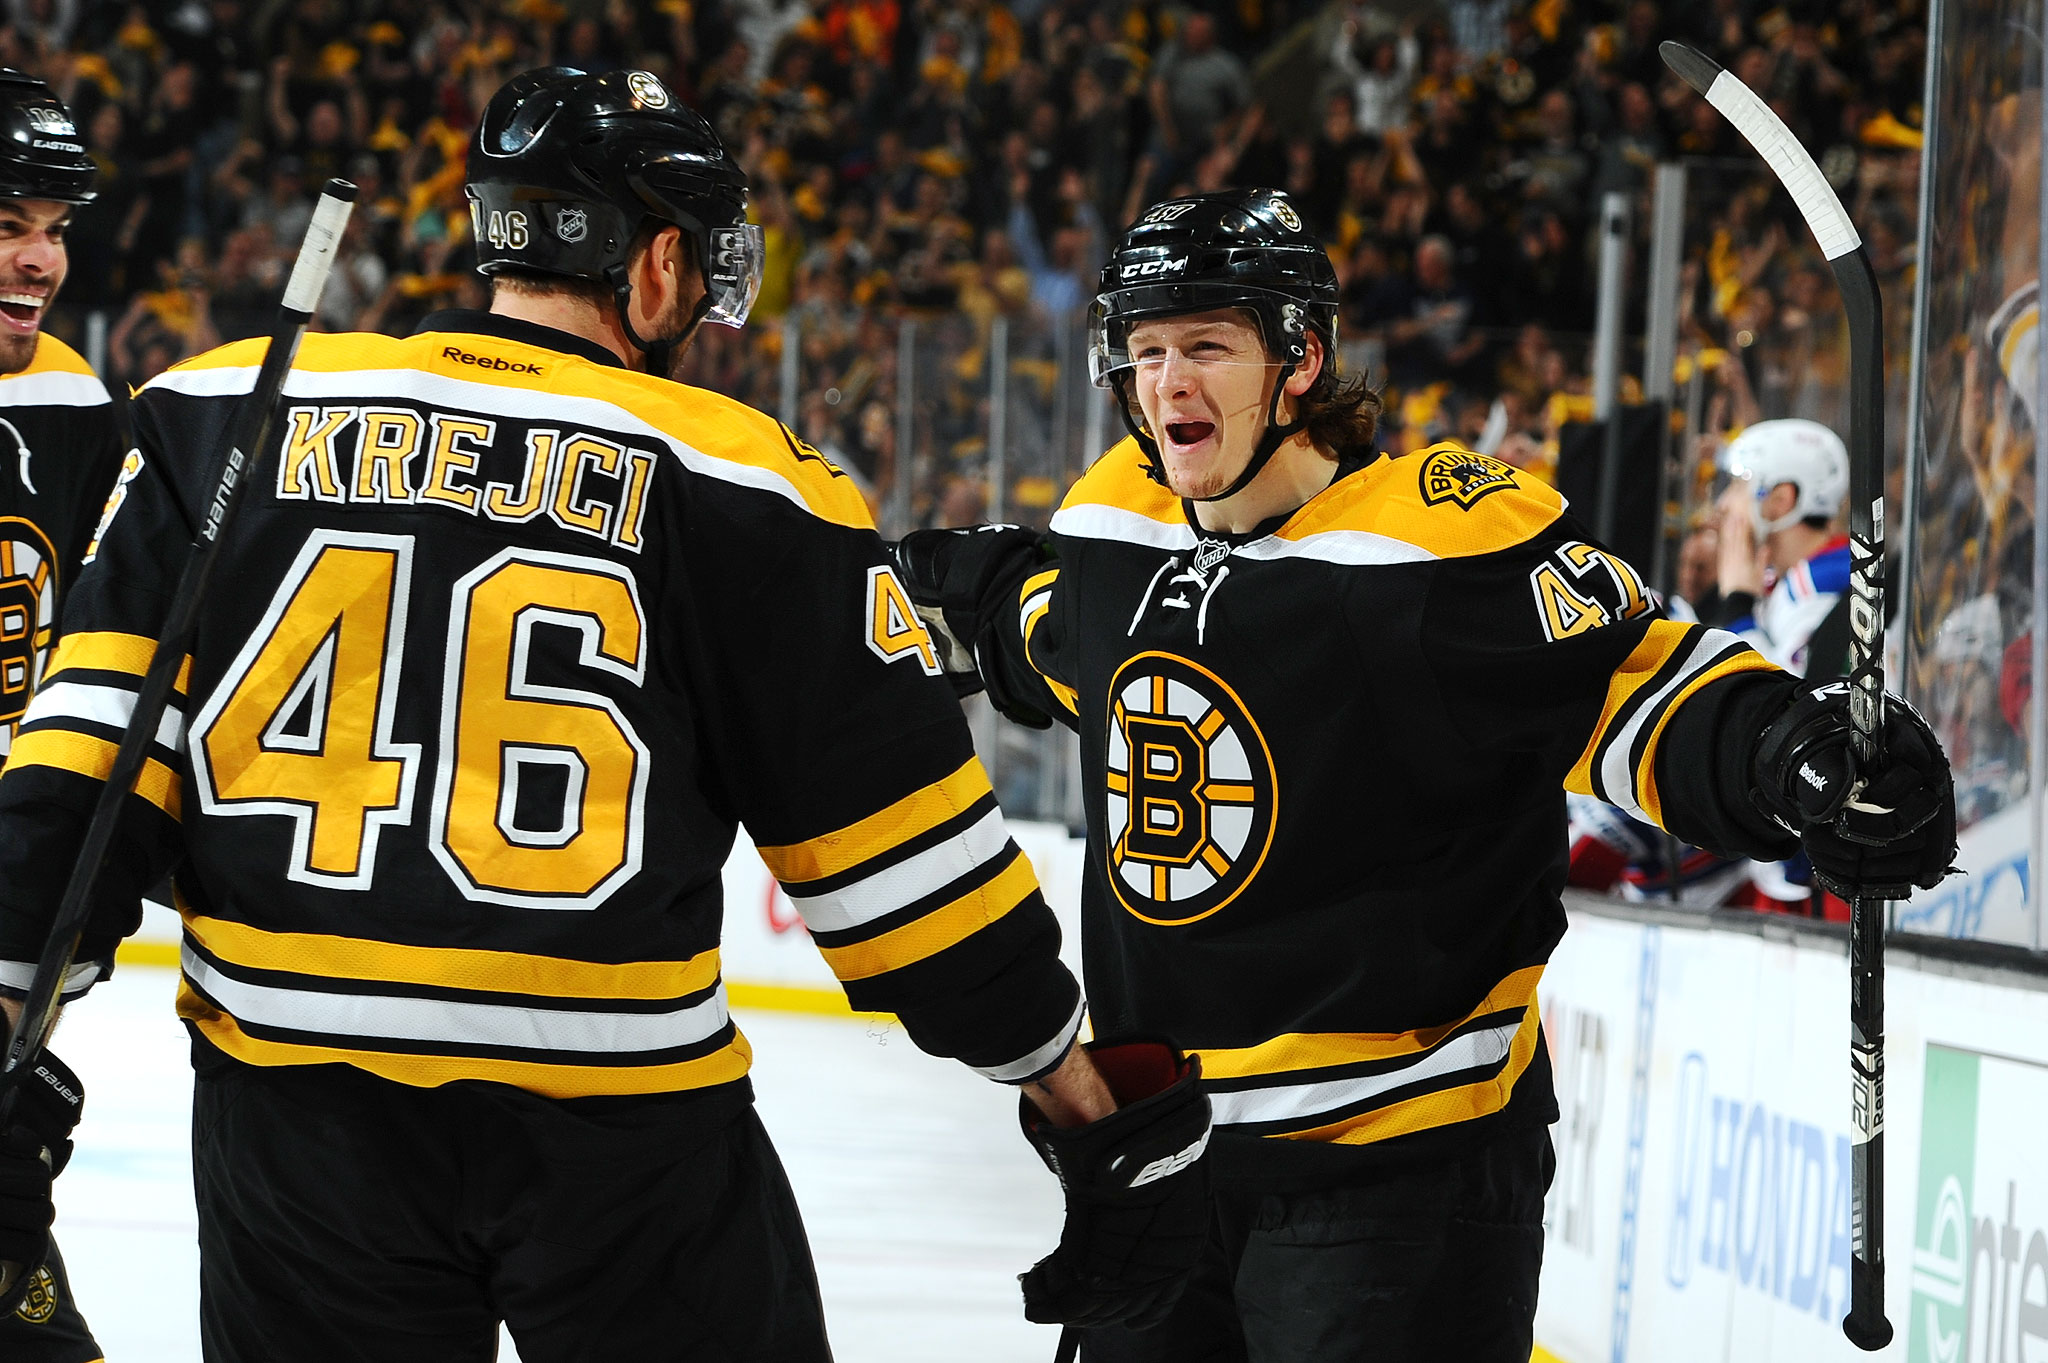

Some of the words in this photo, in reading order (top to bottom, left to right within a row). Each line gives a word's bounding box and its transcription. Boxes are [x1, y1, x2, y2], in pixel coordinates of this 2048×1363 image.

[33, 139, 86, 153] EASTON
[562, 216, 582, 235] NHL
[1144, 203, 1197, 223] 47
[487, 210, 529, 250] 46
[1121, 257, 1187, 279] CCM
[442, 346, 544, 376] Reebok
[276, 406, 658, 554] KREJCI
[1201, 549, 1224, 569] NHL
[1529, 540, 1656, 644] 47
[189, 527, 652, 911] 46
[1798, 761, 1829, 793] Reebok
